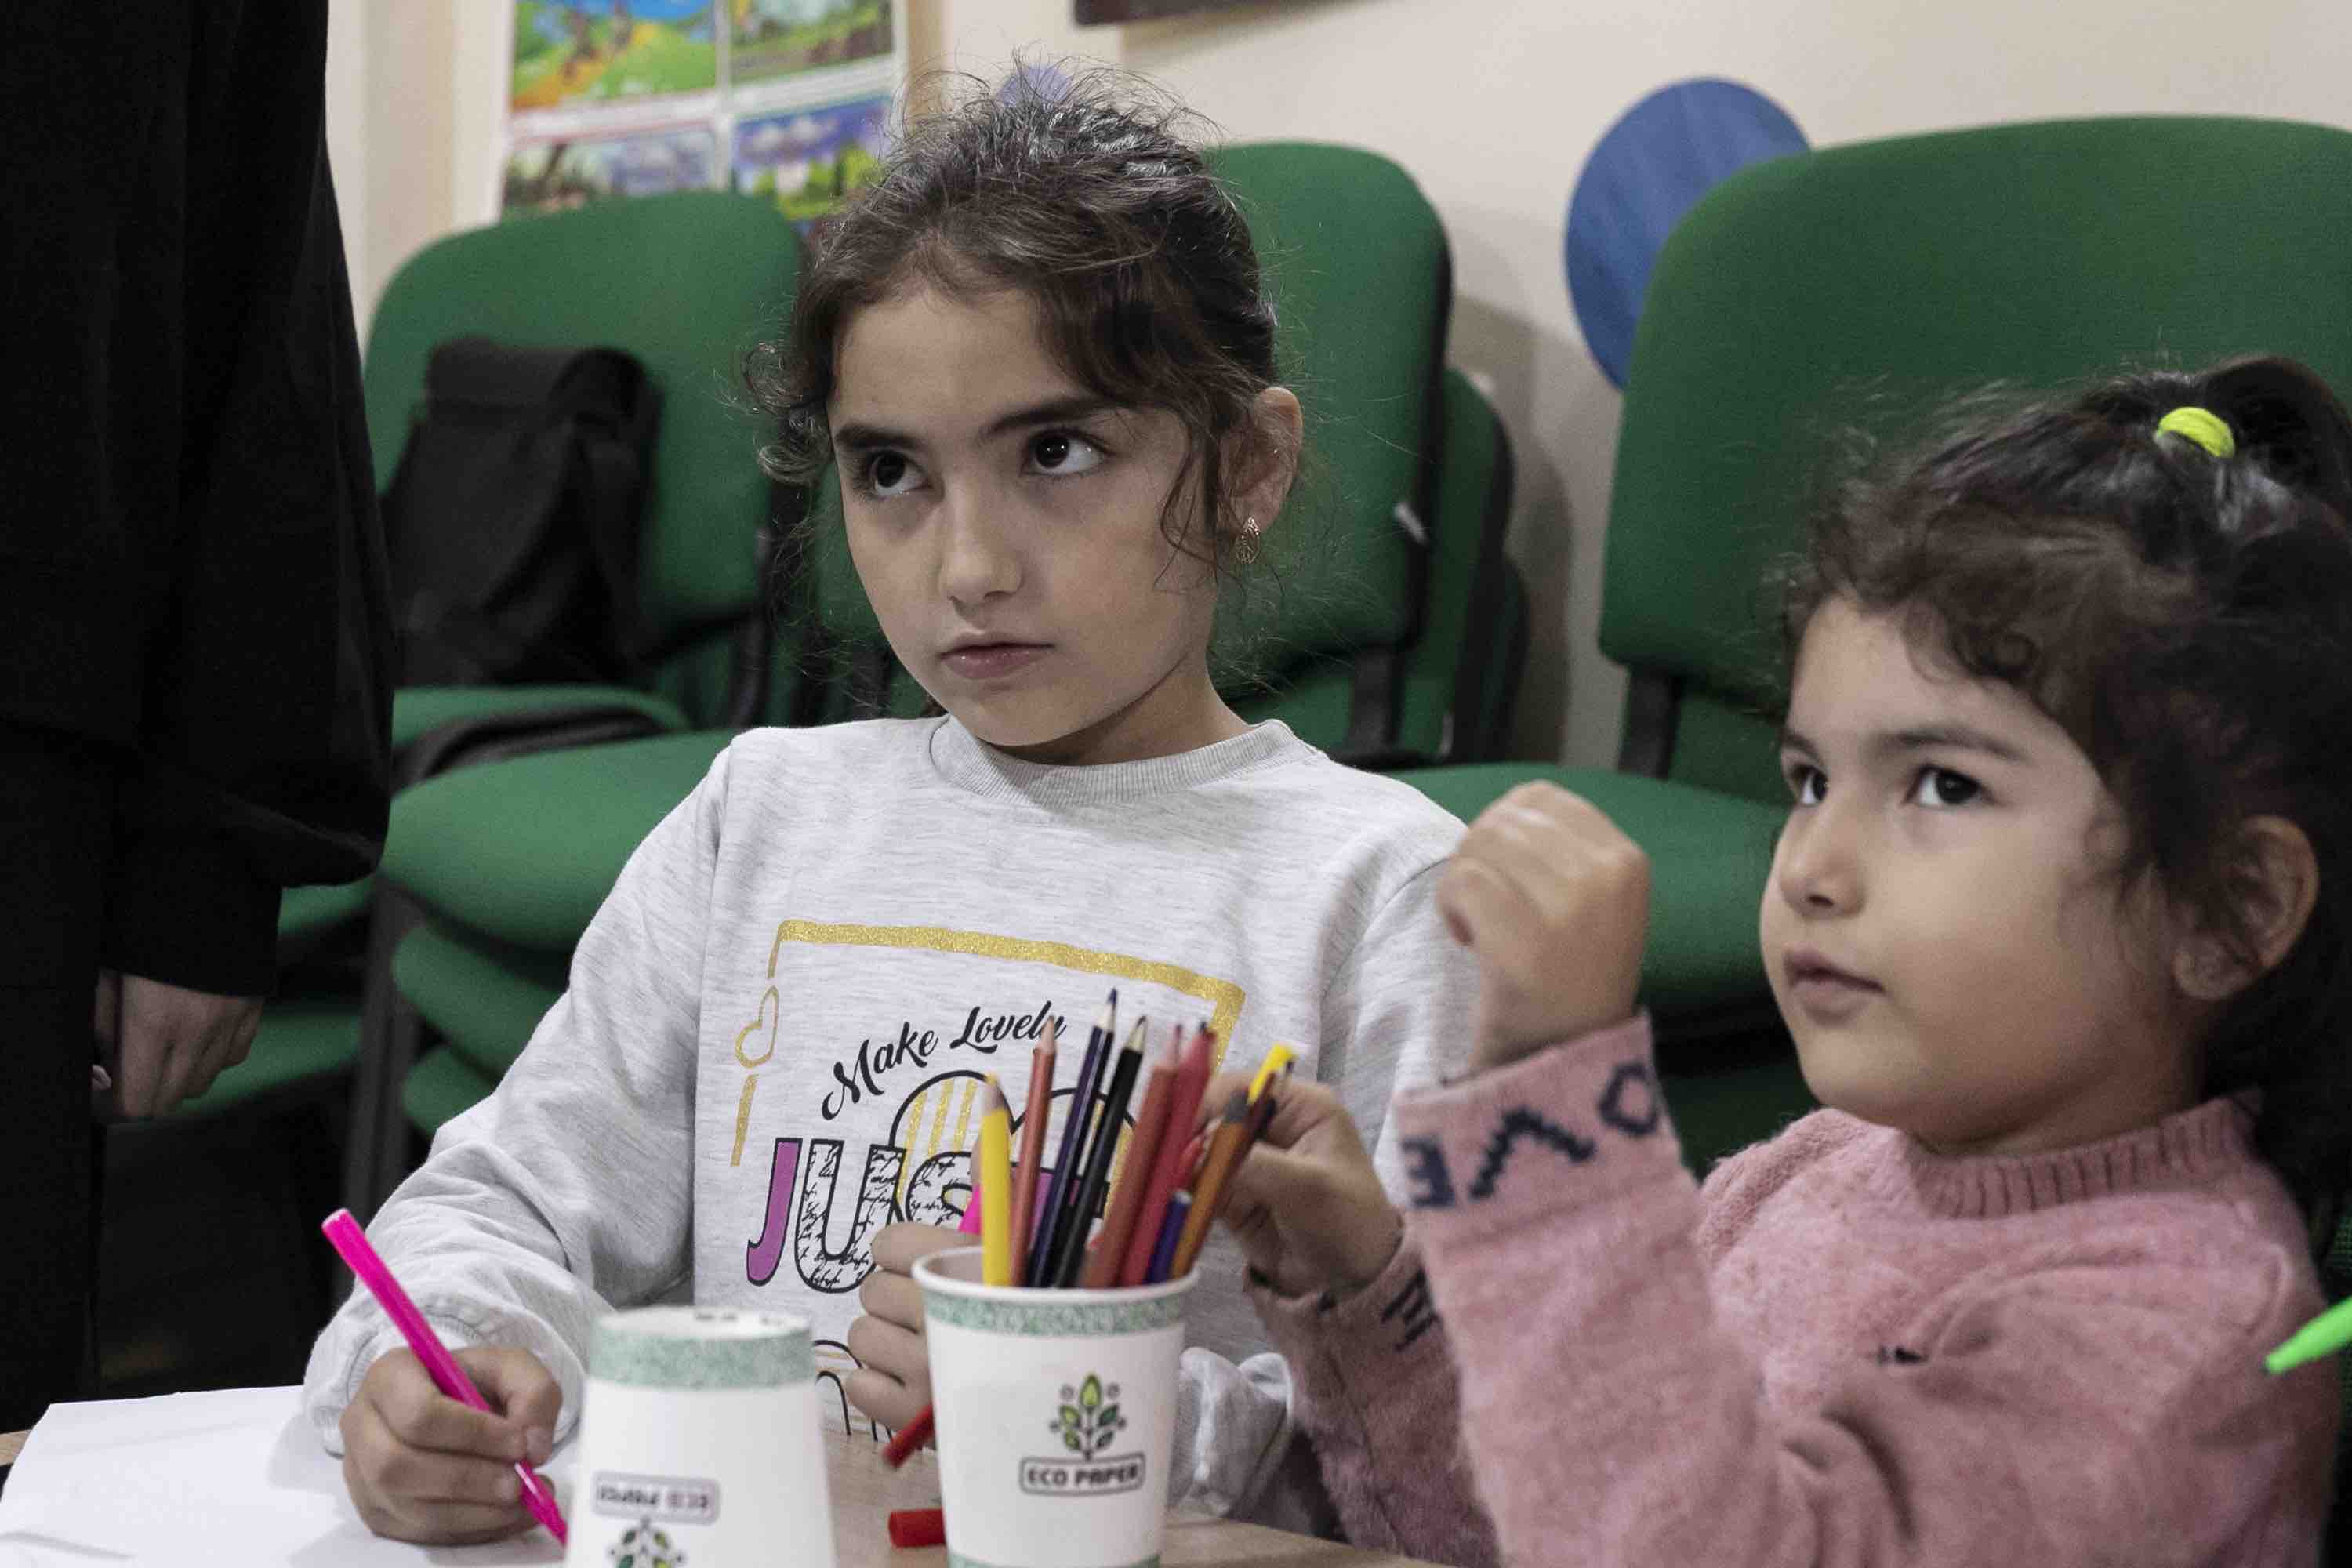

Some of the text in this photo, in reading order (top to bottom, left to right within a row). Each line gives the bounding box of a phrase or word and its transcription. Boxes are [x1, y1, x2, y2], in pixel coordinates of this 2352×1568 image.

[821, 1000, 1067, 1121] Make Lovely
[1028, 1462, 1138, 1485] ECO PAPER
